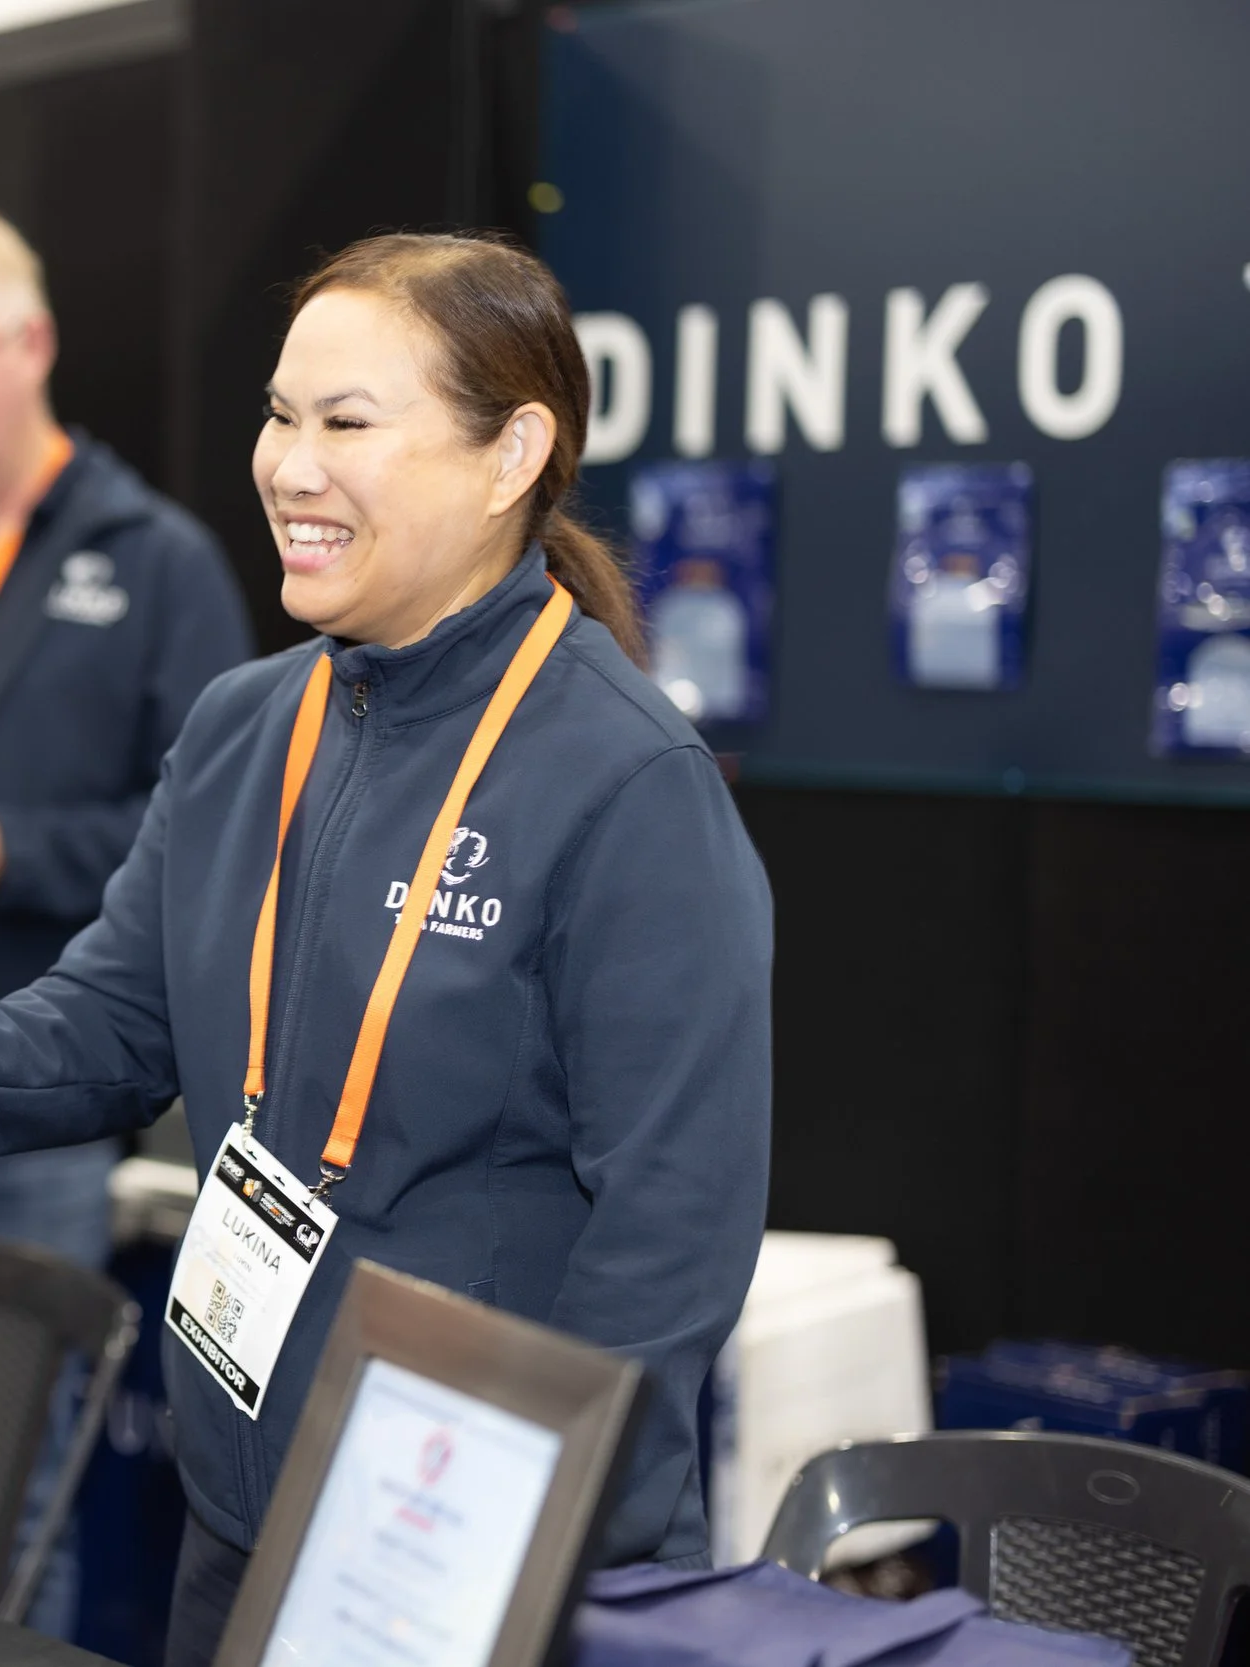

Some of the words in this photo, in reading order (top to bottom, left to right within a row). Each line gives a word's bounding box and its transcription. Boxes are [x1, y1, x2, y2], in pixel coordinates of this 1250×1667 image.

[574, 272, 1124, 465] DINKO
[384, 881, 502, 927] DNKO
[430, 920, 484, 941] FARMERS
[222, 1207, 281, 1275] LUKINA
[180, 1311, 247, 1392] EXHIBITOR
